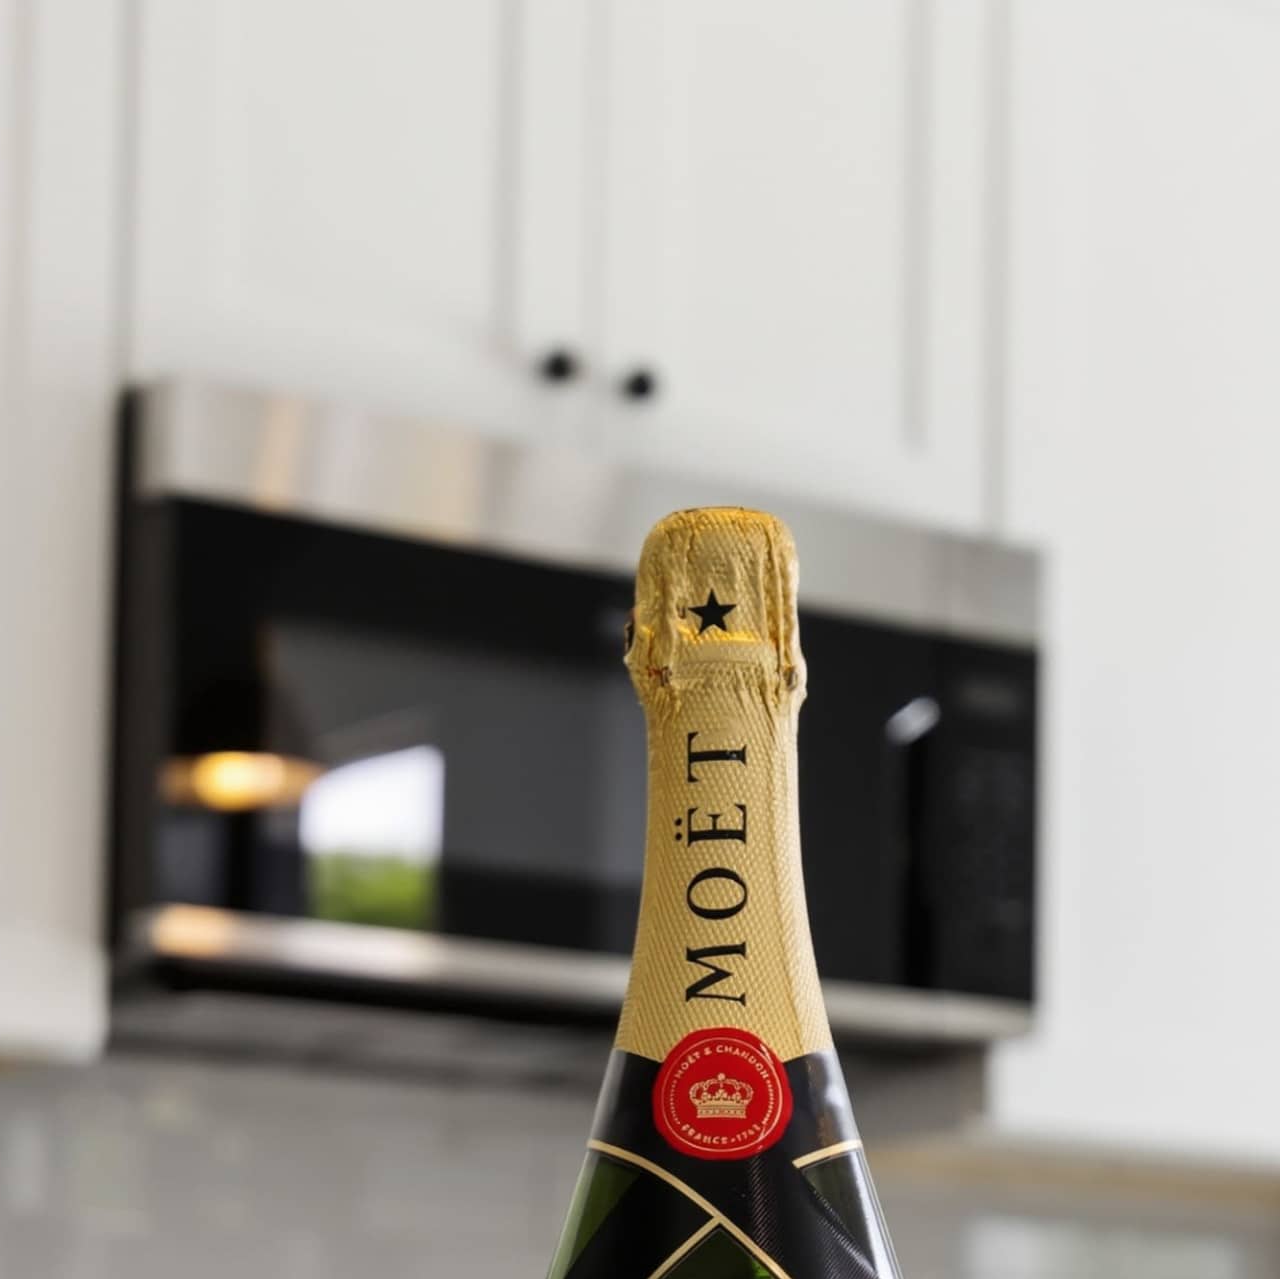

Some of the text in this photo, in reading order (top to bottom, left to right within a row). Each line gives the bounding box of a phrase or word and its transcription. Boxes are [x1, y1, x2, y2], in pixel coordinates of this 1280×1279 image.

[673, 731, 748, 1007] MOËT
[704, 1046, 713, 1056] &
[715, 1044, 769, 1080] CHANDON
[681, 1123, 728, 1144] FRANCE
